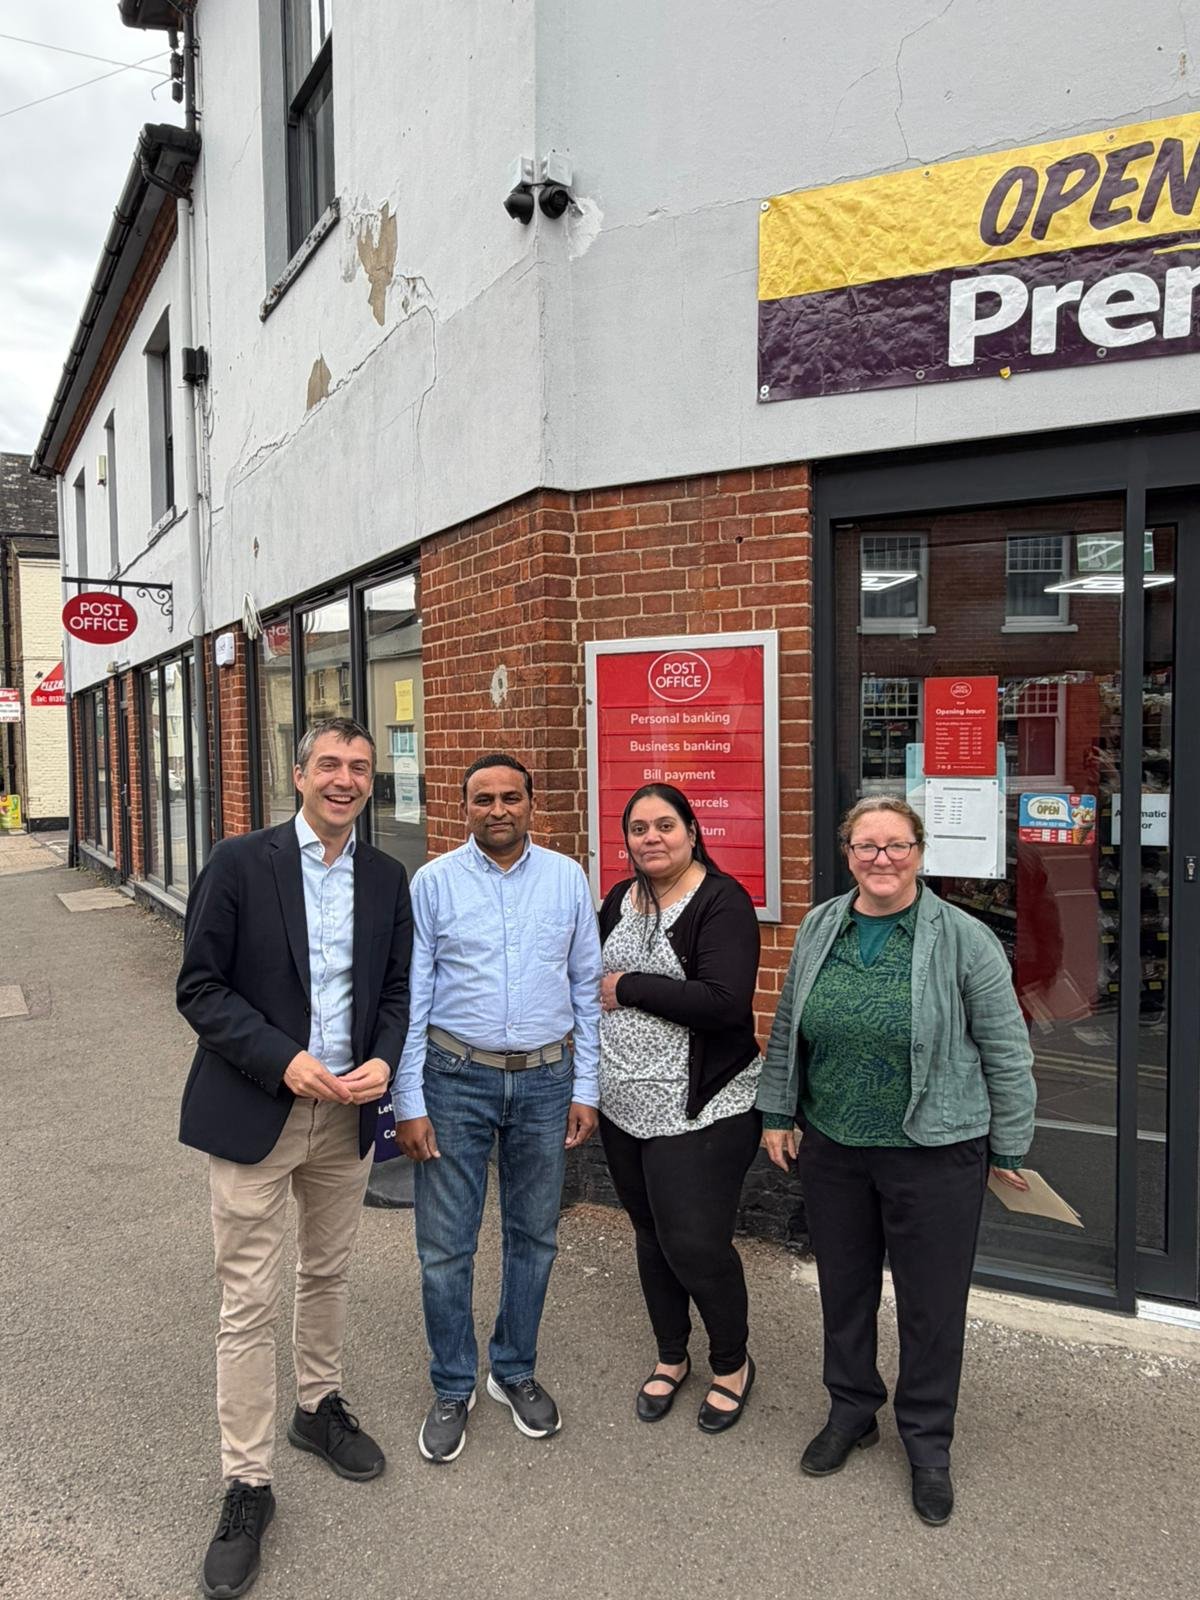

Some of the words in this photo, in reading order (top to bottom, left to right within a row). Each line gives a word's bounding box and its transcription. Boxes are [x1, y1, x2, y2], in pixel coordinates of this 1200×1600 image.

[979, 138, 1200, 247] OPEN
[80, 602, 122, 617] POST
[69, 616, 129, 632] OFFICE
[663, 662, 697, 675] POST
[655, 675, 702, 688] OFFICE
[630, 713, 680, 725] Personal
[682, 712, 731, 725] banking
[936, 708, 965, 716] Opening
[630, 741, 680, 752] Business
[683, 740, 731, 753] banking
[643, 769, 661, 780] Bill
[664, 770, 716, 782] payment
[1037, 805, 1059, 815] OPEN
